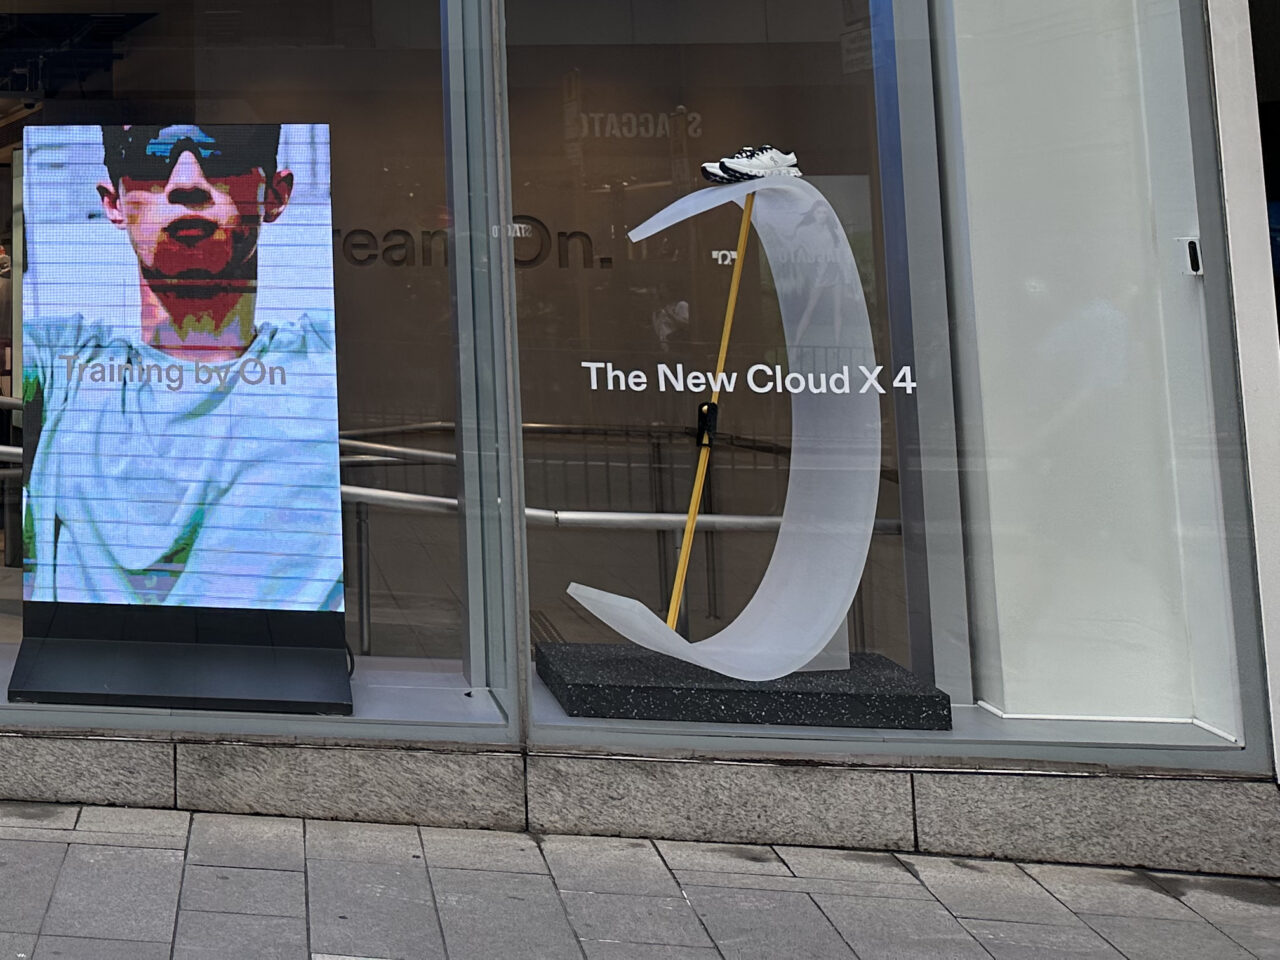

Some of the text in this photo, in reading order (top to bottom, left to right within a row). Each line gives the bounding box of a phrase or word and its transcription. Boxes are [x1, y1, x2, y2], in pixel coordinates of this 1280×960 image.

[58, 355, 287, 393] Training by On
[581, 361, 917, 395] The New Cloud X 4
